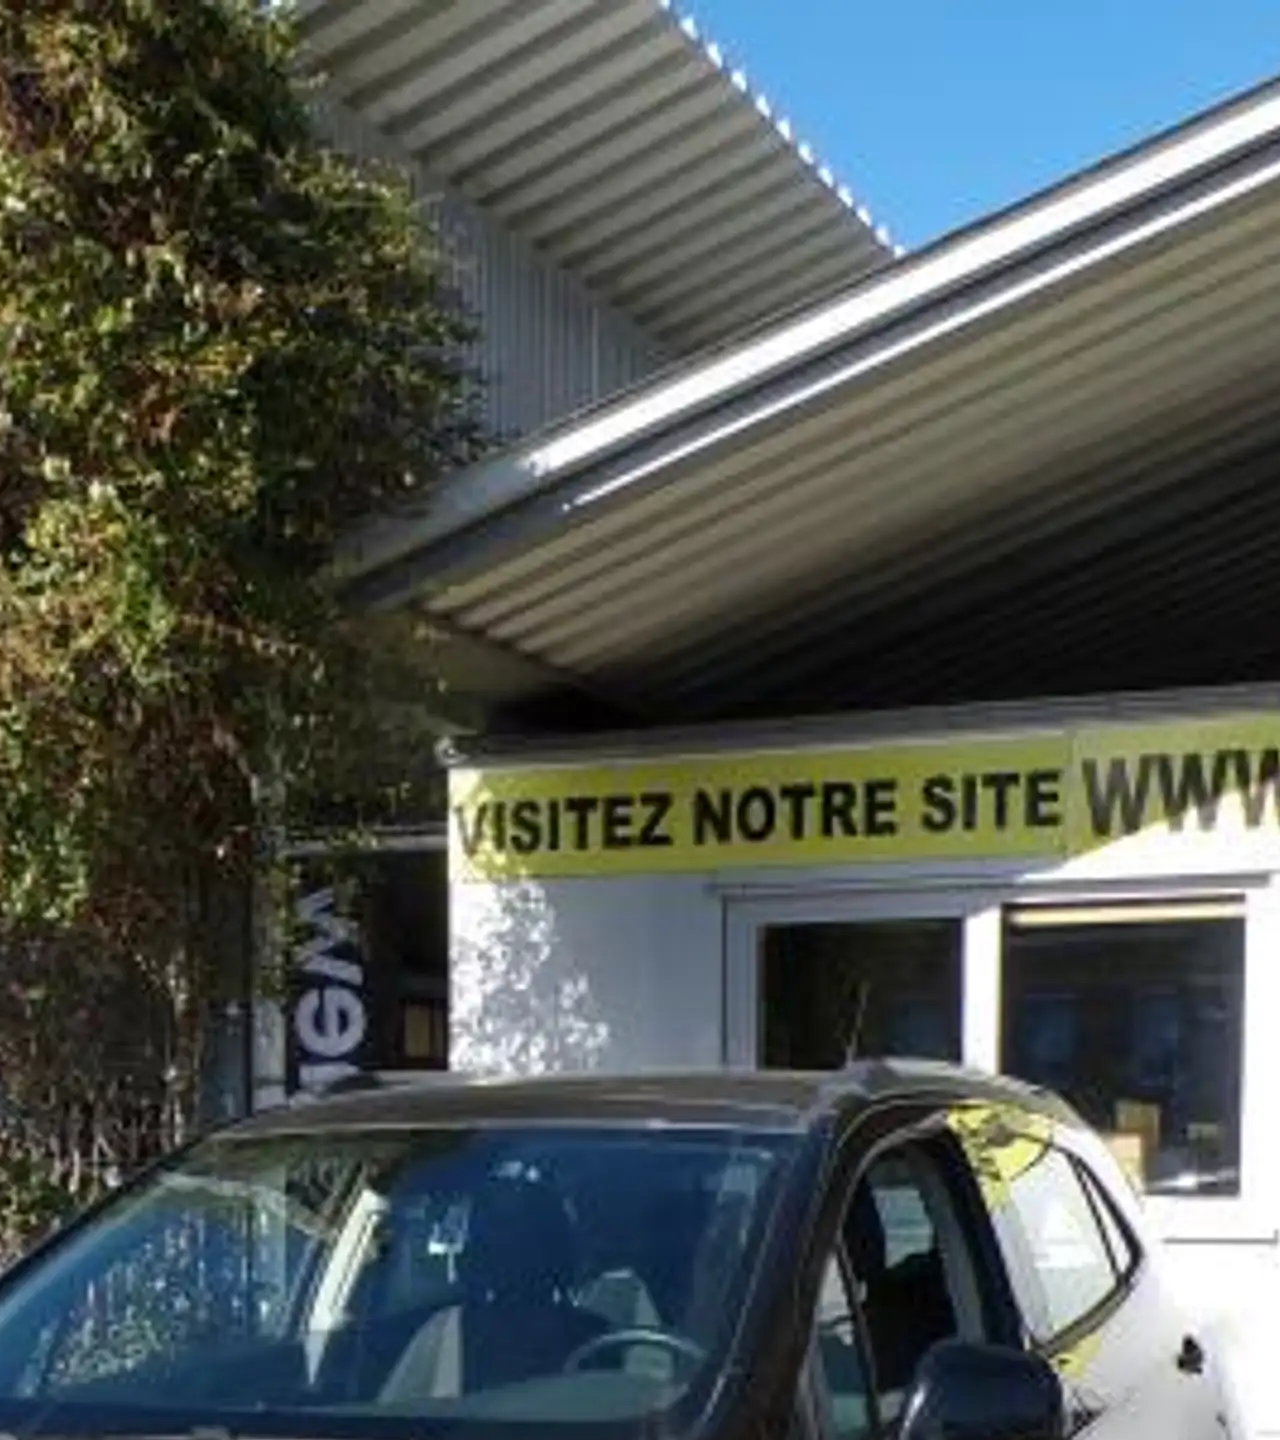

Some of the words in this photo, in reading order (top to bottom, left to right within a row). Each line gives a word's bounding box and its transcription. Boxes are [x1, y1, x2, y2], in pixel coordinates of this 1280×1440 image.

[453, 792, 674, 856] VISITEZ
[693, 779, 897, 846] NOTRE
[921, 770, 1062, 833] SITE
